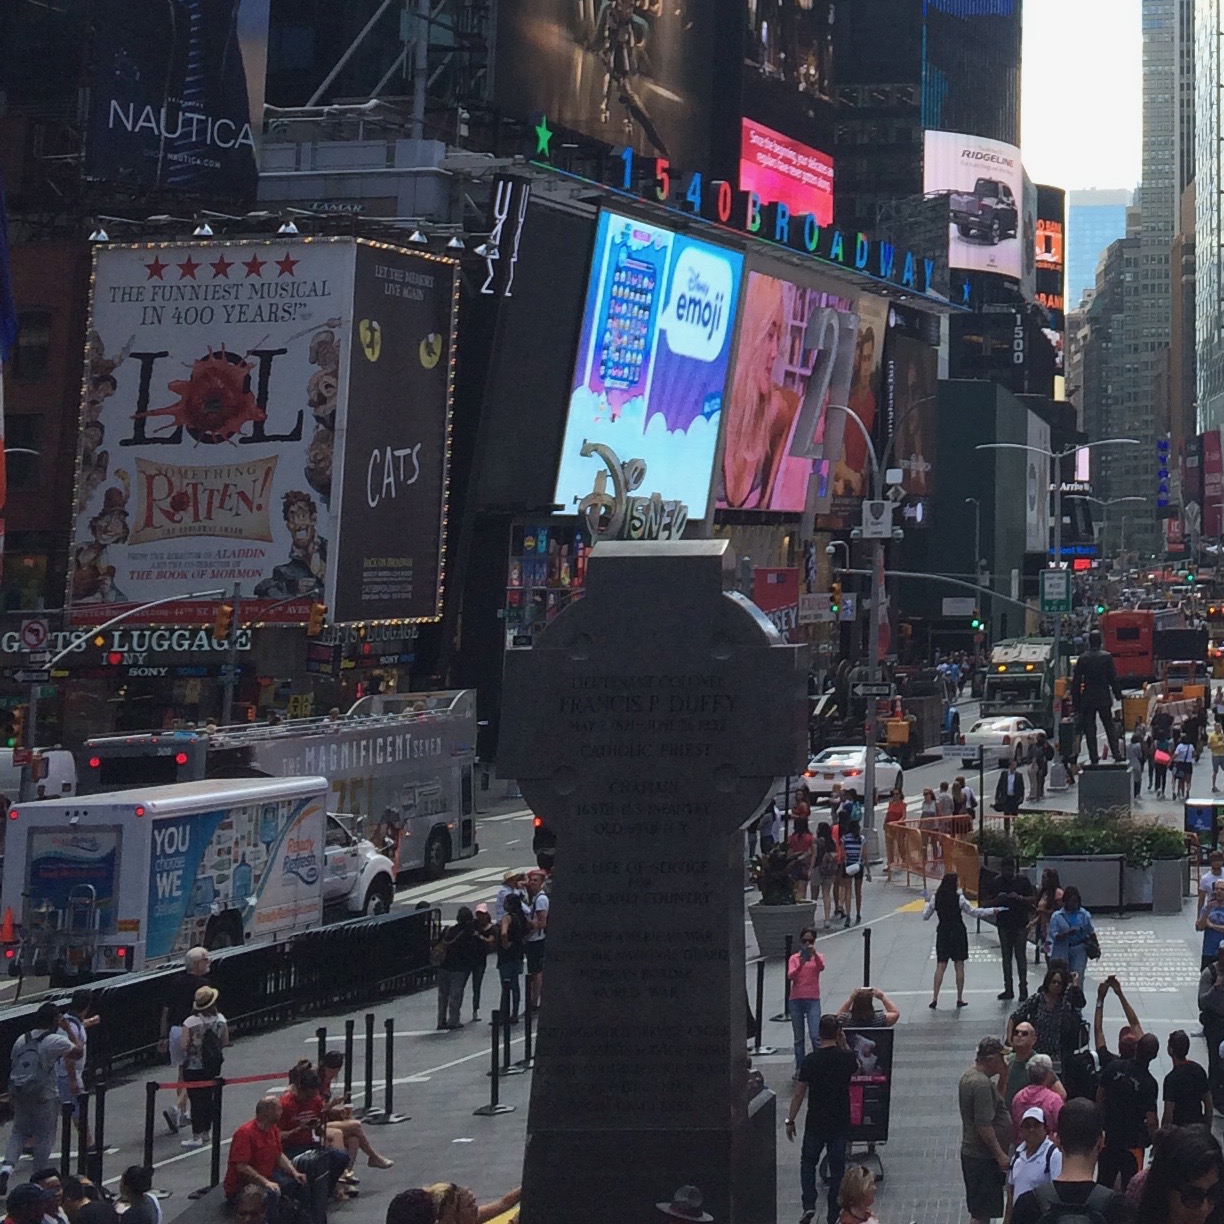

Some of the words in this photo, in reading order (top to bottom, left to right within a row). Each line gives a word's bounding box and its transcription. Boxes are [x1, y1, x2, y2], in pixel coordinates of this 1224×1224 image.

[108, 99, 255, 150] NAUTICA
[167, 152, 222, 168] NAUTICA.COM
[621, 146, 732, 223] 1540
[747, 192, 935, 292] BROADWAY
[109, 285, 146, 303] THE
[150, 283, 243, 302] FUNNIEST
[249, 280, 331, 300] MUSICAL
[140, 305, 166, 325] IN
[171, 306, 215, 325] 400
[676, 292, 724, 341] emoji
[1013, 313, 1024, 364] 1500
[119, 347, 304, 446] LOL
[154, 466, 257, 481] SOMETHING
[367, 442, 423, 508] CATS
[140, 467, 273, 531] ROTTEN!
[214, 548, 267, 560] ALADDIN
[129, 570, 153, 581] THE
[155, 570, 188, 580] BOOK
[191, 569, 208, 580] OF
[209, 568, 264, 579] MORMON
[2, 631, 87, 653] GTS
[111, 630, 252, 652] LUGGAGE
[123, 653, 147, 665] NY
[128, 667, 169, 677] SONY
[669, 694, 739, 714] DUFFY
[305, 733, 412, 775] MAGNIFICENT
[413, 737, 442, 759] SEVEN
[154, 824, 191, 854] YOU
[286, 836, 315, 855] Ready
[155, 855, 186, 873] choose
[283, 854, 316, 875] Refresh
[155, 871, 183, 899] WE
